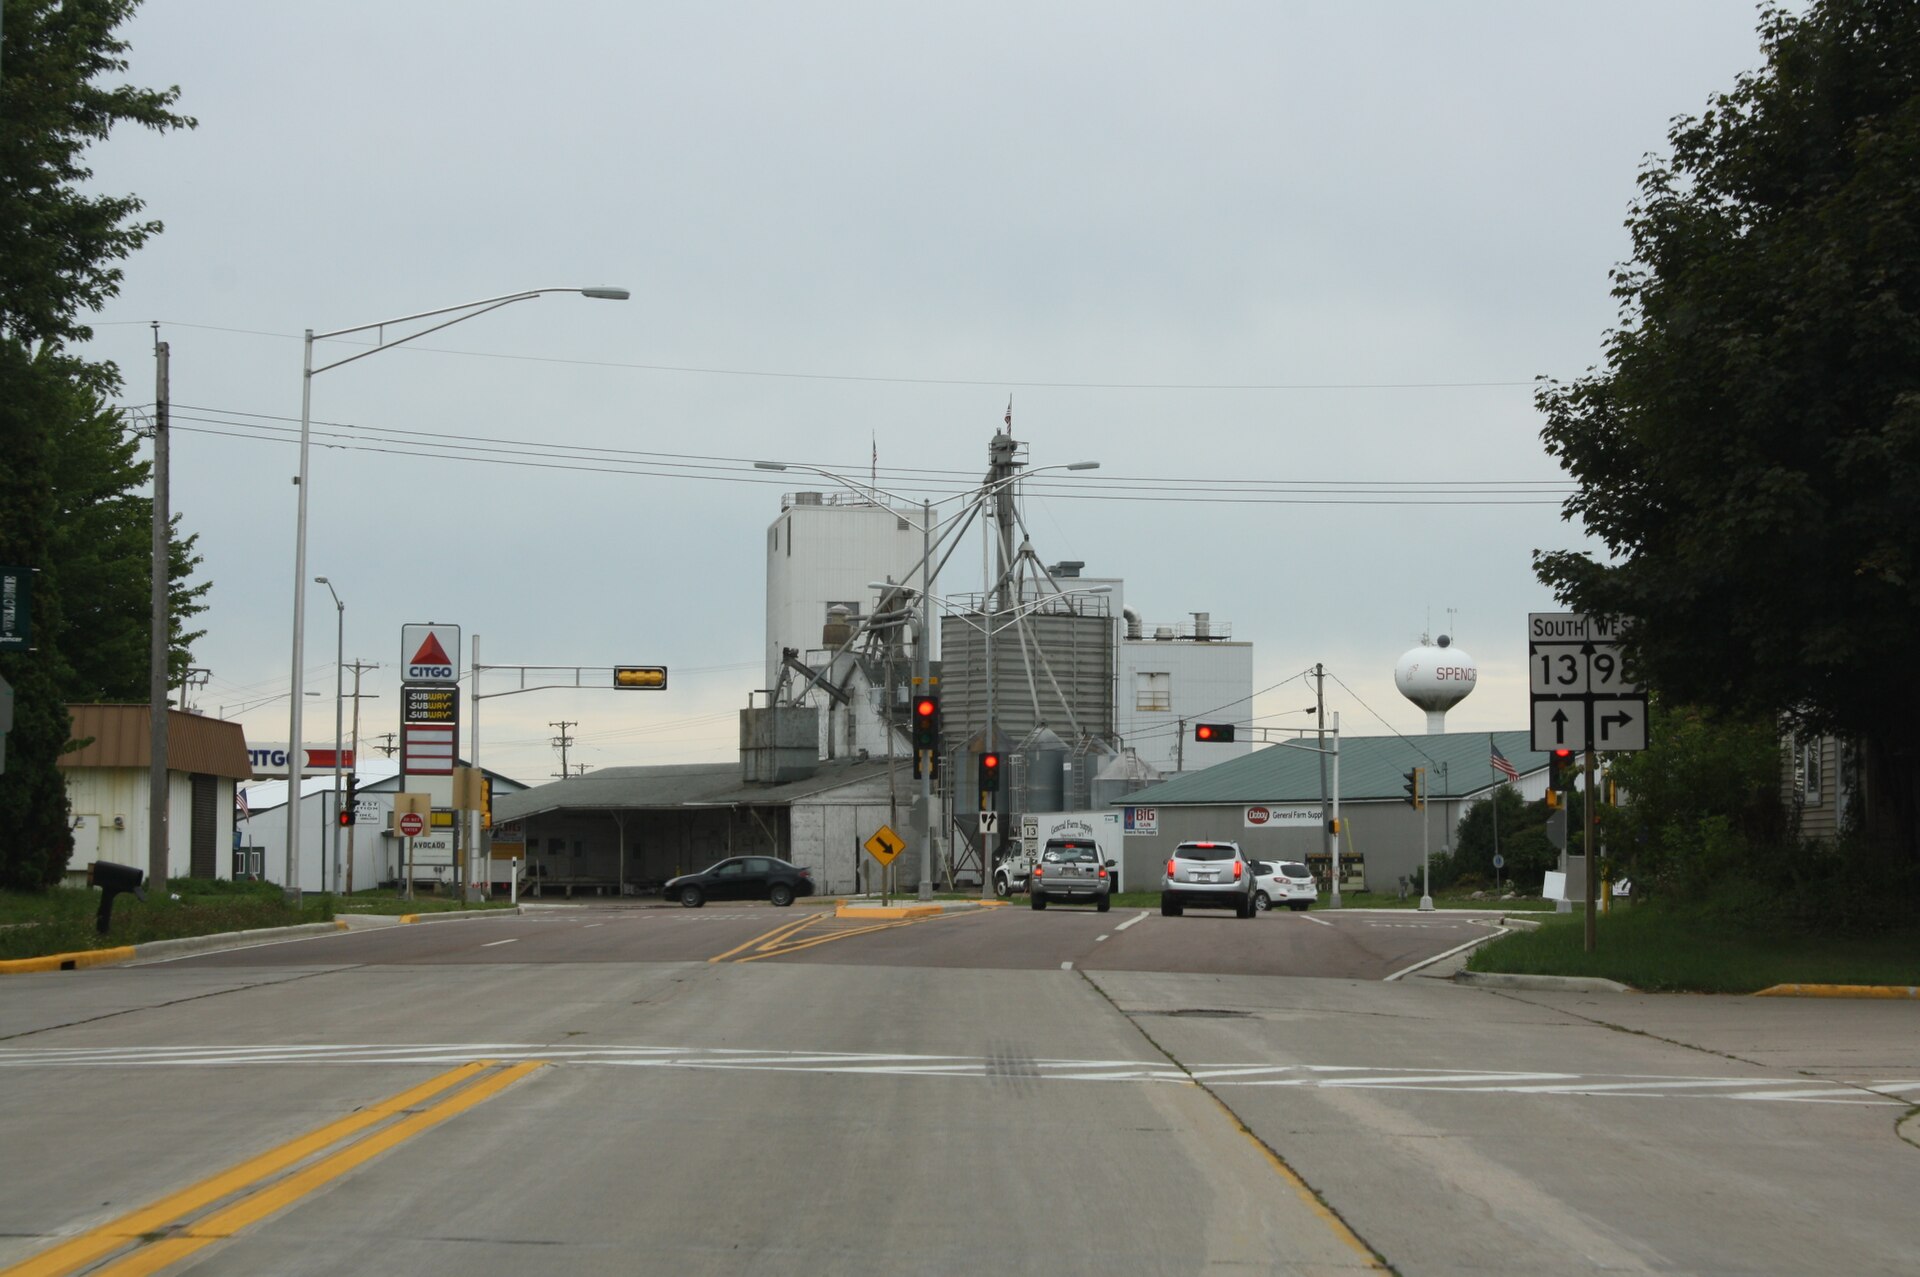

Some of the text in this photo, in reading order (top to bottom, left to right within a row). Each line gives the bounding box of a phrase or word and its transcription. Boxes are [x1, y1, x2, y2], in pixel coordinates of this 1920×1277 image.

[3, 575, 17, 631] WELCOME
[1533, 618, 1585, 637] SOUTH
[1596, 618, 1631, 637] WES
[409, 666, 452, 678] CITGO
[1436, 667, 1477, 681] SPENCE
[1541, 654, 1578, 685] 13
[409, 711, 452, 719] SUBWAY
[247, 749, 290, 767] ITG
[1272, 810, 1323, 820] General Farm Suppl
[1026, 828, 1036, 836] 13
[1051, 819, 1093, 837] General Farm Supply
[1025, 849, 1037, 857] 25
